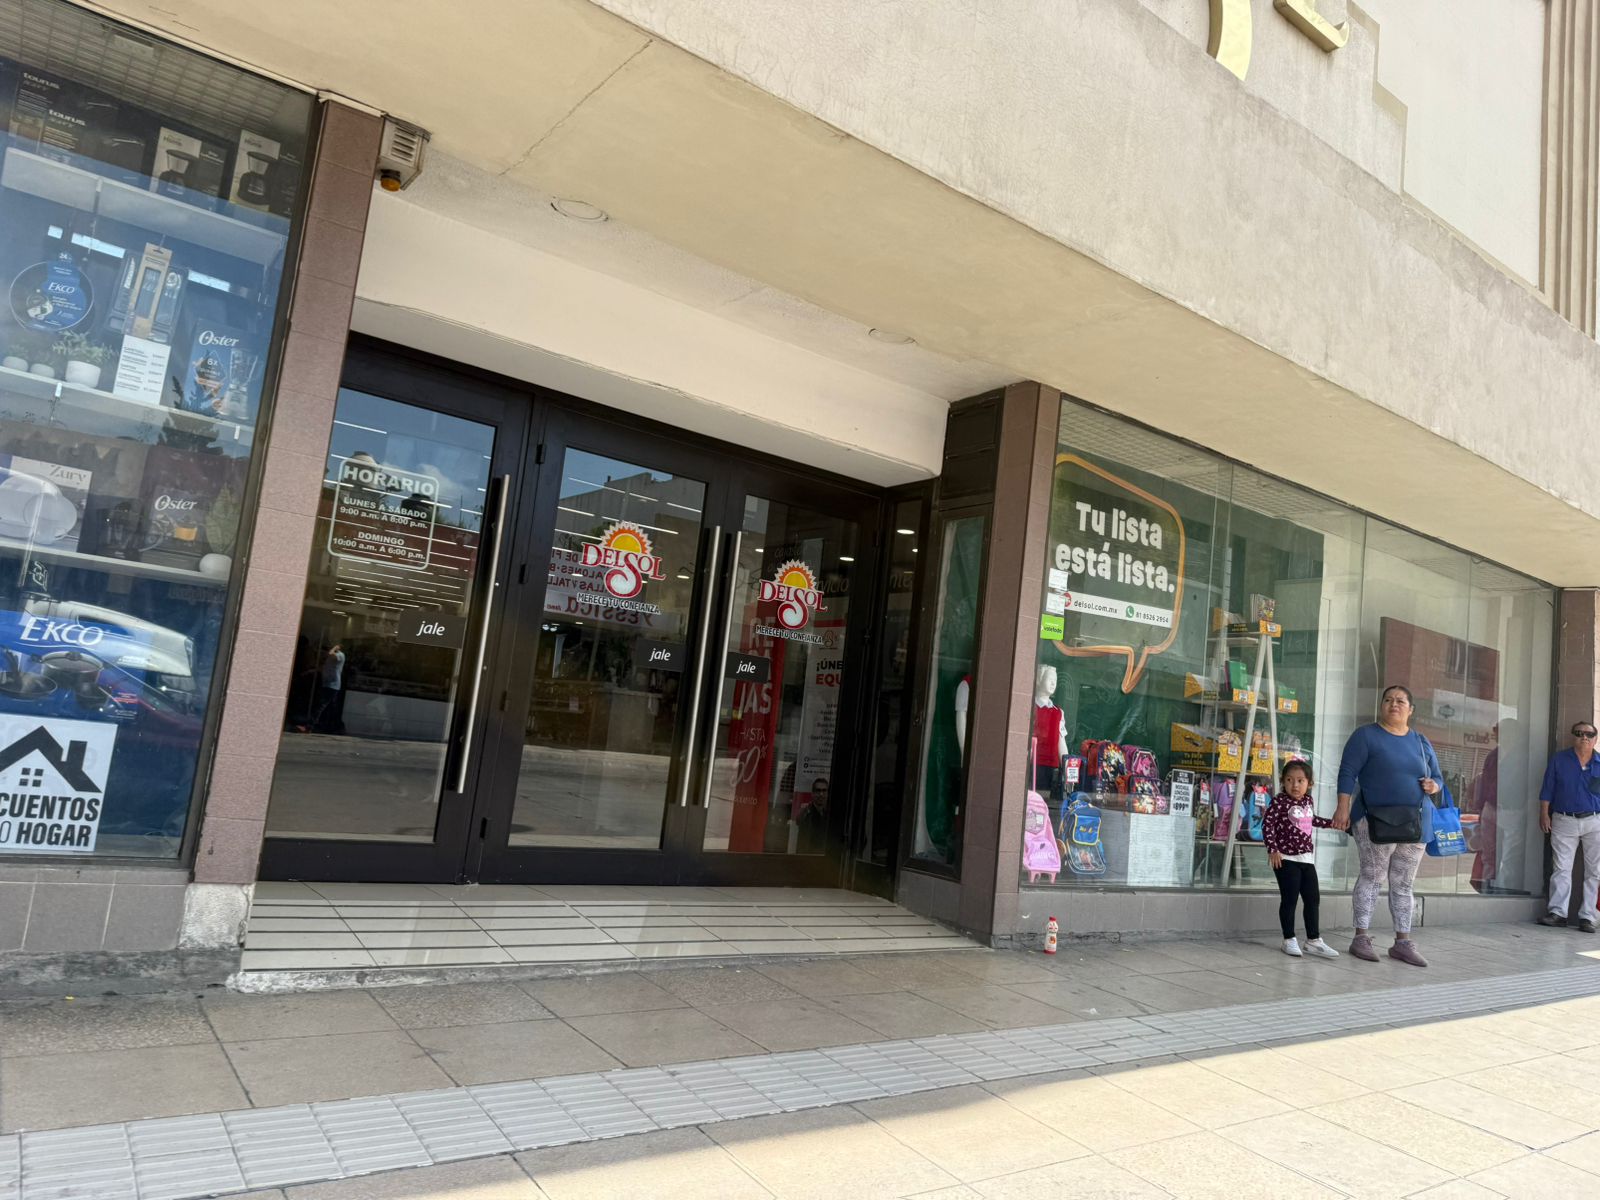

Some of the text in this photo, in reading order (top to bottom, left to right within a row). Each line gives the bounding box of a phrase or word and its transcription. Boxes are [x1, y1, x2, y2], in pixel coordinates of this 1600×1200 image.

[48, 109, 86, 127] taurus
[48, 282, 75, 294] EKCO
[198, 330, 240, 347] Oster
[343, 464, 435, 497] HORARIO
[154, 494, 198, 511] Oster
[343, 496, 377, 509] LUNES
[378, 503, 386, 512] A
[340, 506, 360, 516] 9:00
[360, 511, 380, 520] a.m.
[409, 521, 428, 529] p.m.
[1075, 501, 1163, 550] Tu lista
[358, 531, 405, 546] DOMINGO
[332, 537, 357, 548] 10:00
[358, 542, 378, 551] a.m.
[387, 547, 407, 556] 6:00
[407, 552, 426, 560] p.m.
[1055, 541, 1175, 593] está lista.
[577, 592, 607, 607] MERECE
[608, 597, 619, 608] TU
[1073, 600, 1118, 614] delsol.com.mx
[20, 616, 104, 646] EKCO
[416, 620, 446, 637] jale
[755, 624, 781, 637] MERECE
[648, 648, 671, 662] jale
[736, 660, 756, 674] jale
[16, 821, 92, 847] HOGAR
